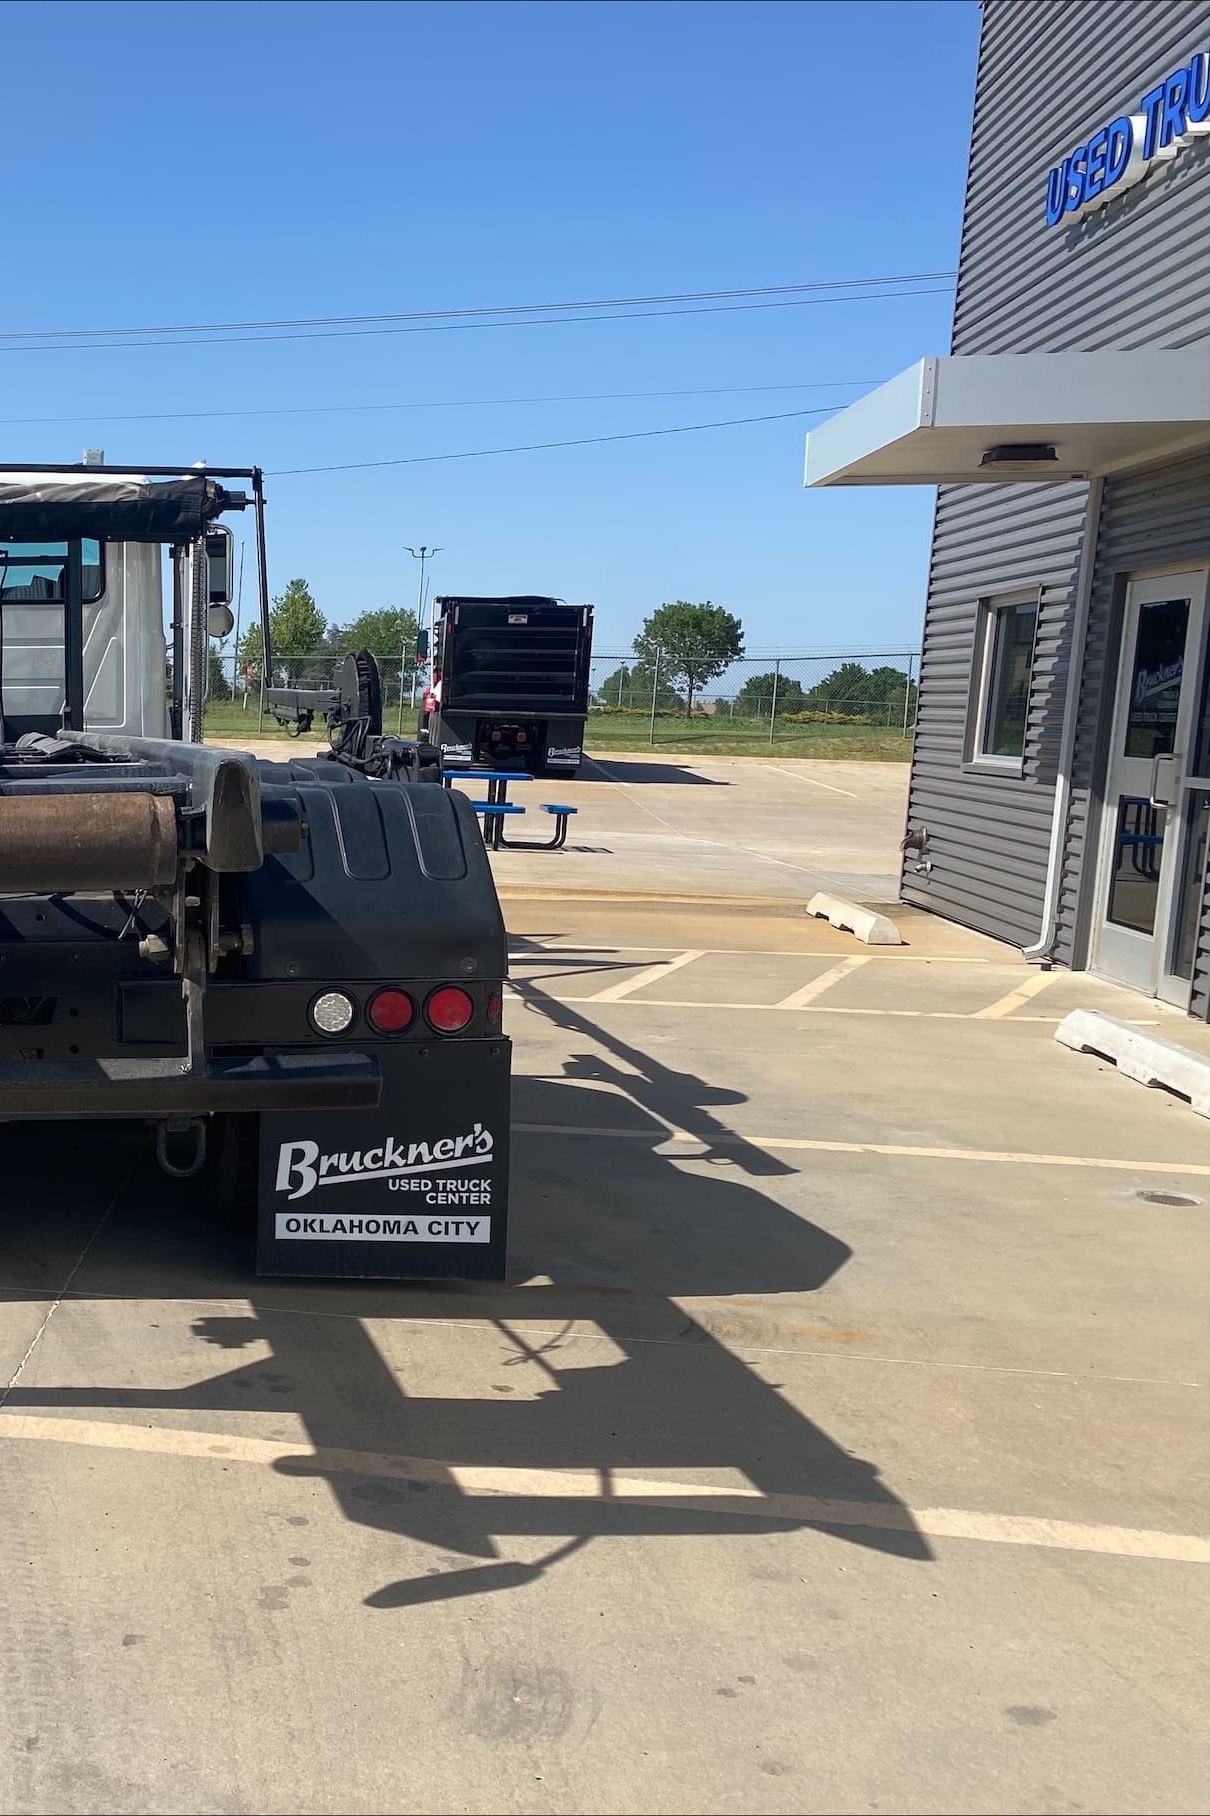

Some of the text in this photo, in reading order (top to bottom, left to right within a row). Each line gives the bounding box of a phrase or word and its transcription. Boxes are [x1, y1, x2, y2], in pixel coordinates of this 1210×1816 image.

[1045, 115, 1133, 226] USED
[275, 1122, 494, 1201] Bruckner's
[388, 1178, 492, 1192] USED TRUCK
[425, 1192, 491, 1205] CENTER
[285, 1218, 481, 1236] OKLAHOMA CITY
